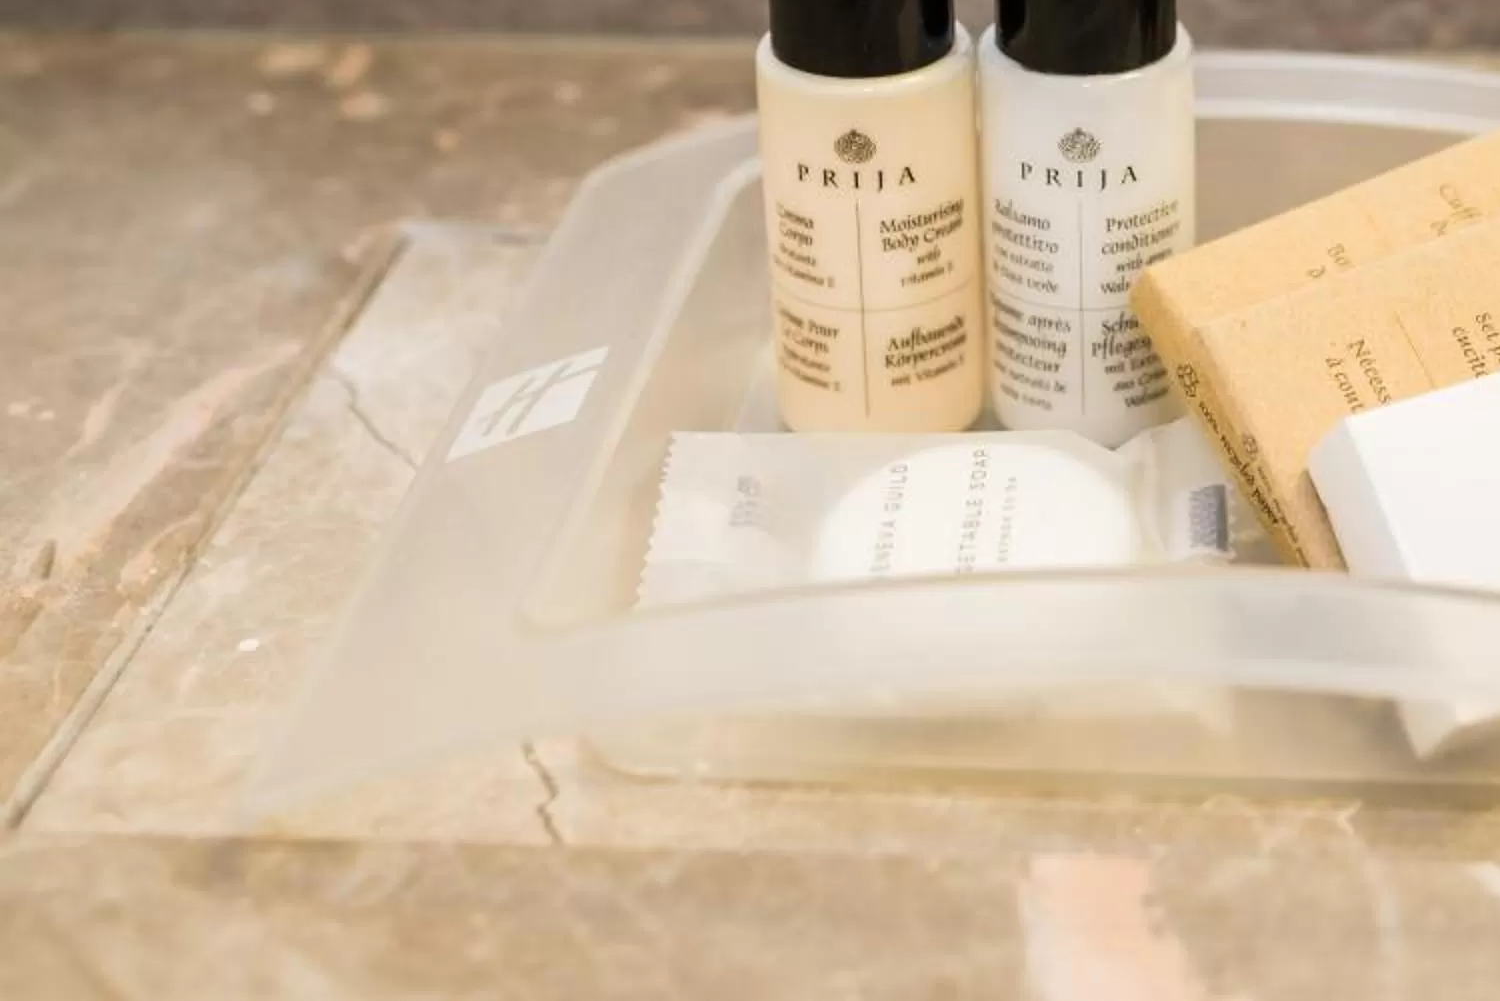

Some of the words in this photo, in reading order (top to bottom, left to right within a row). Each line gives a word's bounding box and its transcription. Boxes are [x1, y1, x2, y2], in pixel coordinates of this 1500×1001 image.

[797, 162, 916, 192] PRIJA
[1021, 162, 1138, 191] PRIJA
[881, 232, 919, 253] Body
[1475, 311, 1500, 342] Set
